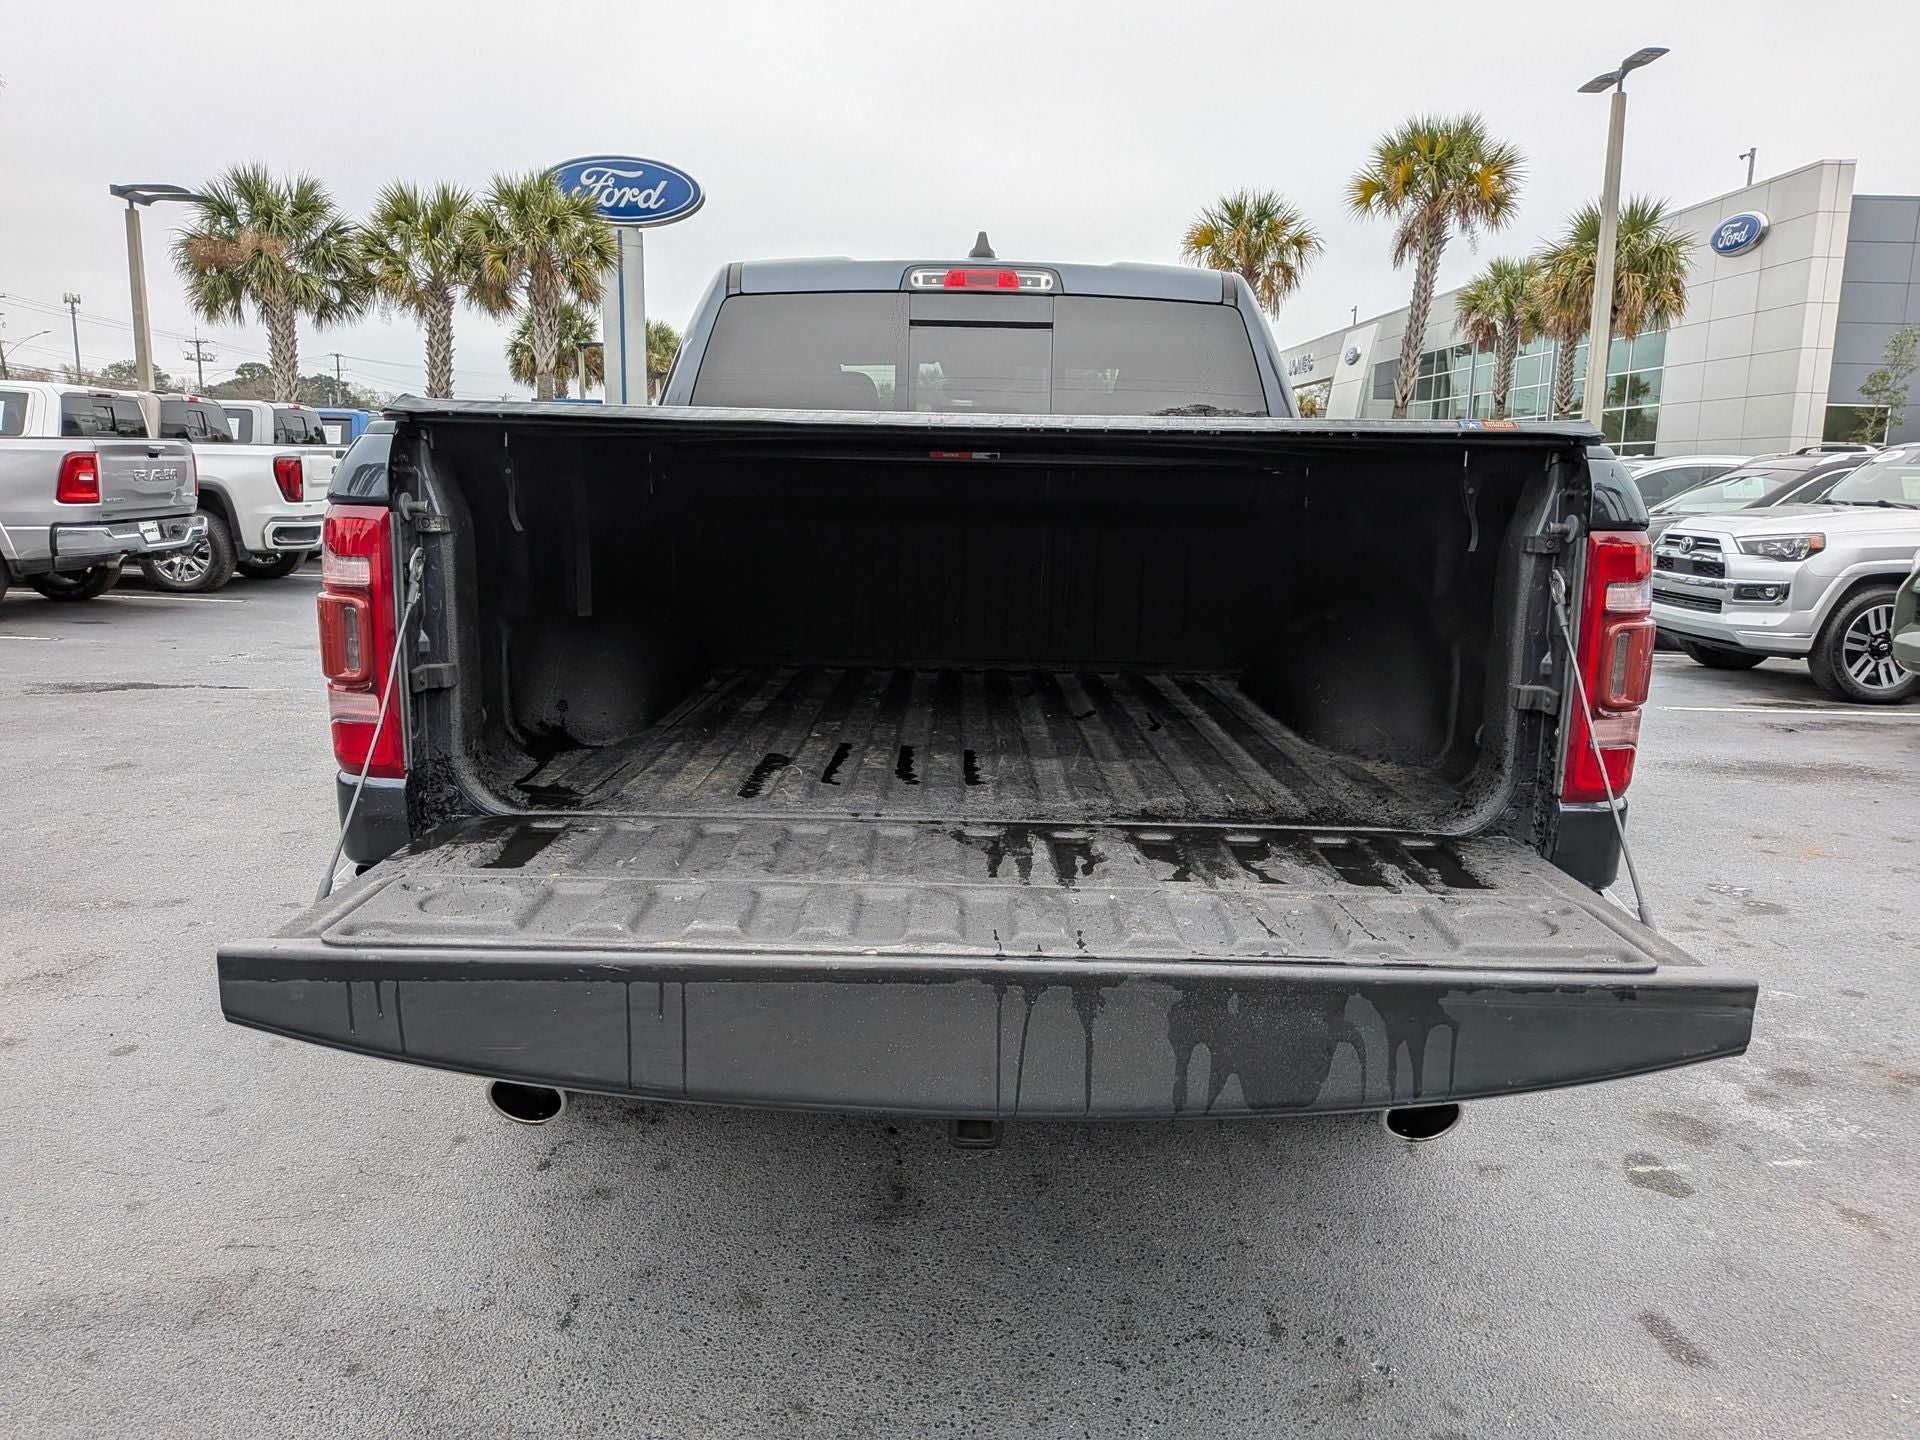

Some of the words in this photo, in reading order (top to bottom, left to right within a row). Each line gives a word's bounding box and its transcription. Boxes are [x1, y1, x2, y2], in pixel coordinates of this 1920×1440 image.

[572, 167, 668, 209] Ford
[1717, 222, 1749, 248] Ford
[133, 468, 178, 481] RAM
